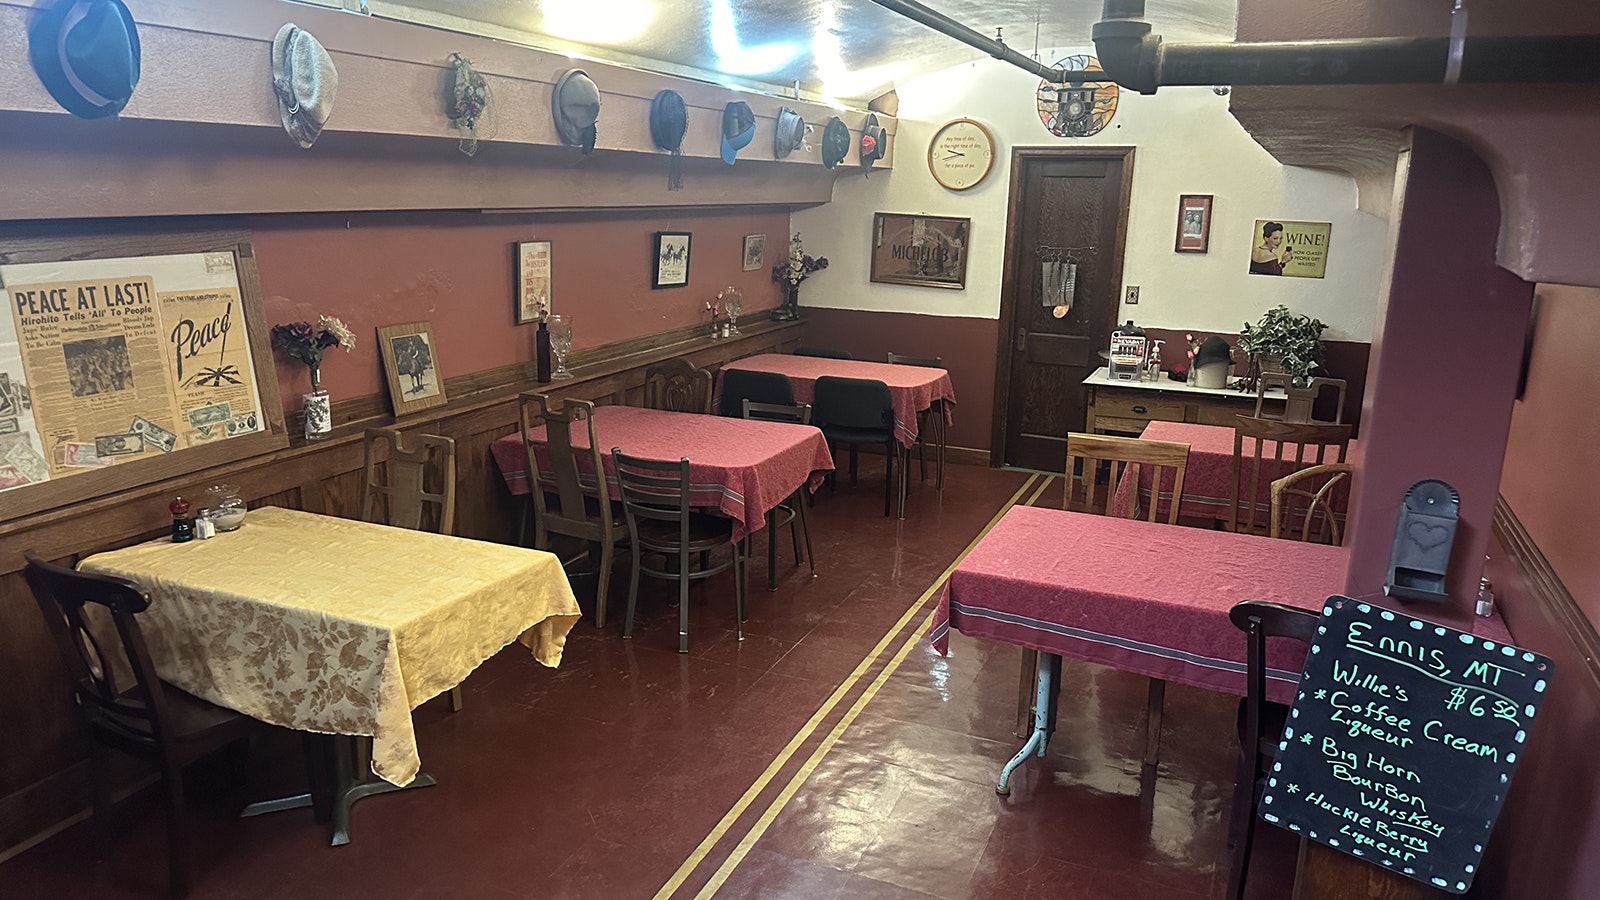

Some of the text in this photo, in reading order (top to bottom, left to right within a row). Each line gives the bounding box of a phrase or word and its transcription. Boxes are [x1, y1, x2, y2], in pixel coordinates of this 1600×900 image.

[892, 244, 948, 262] MICHELOB
[1286, 232, 1326, 246] WINE!
[15, 282, 150, 316] PEACE AT LAST!
[21, 315, 59, 326] Hirohito
[63, 313, 85, 322] Tells
[110, 308, 122, 316] To
[124, 306, 152, 316] People
[1332, 660, 1409, 702] Willie's
[1463, 660, 1526, 687] MT
[1330, 691, 1498, 763] Coffee Cream
[1330, 710, 1414, 749] Liqueur
[1322, 736, 1421, 784] Big Horn
[1339, 825, 1417, 862] Liqueur
